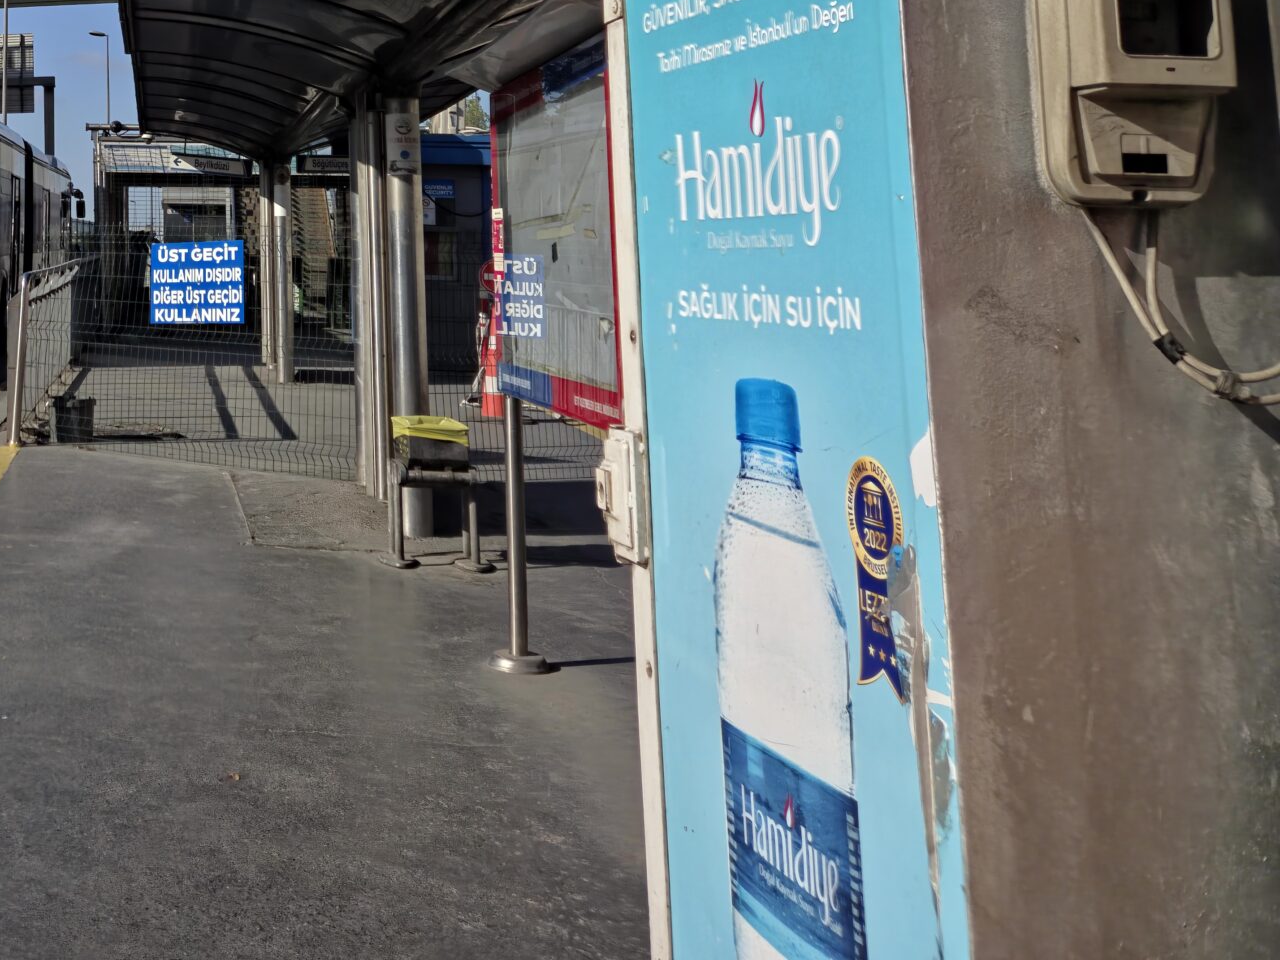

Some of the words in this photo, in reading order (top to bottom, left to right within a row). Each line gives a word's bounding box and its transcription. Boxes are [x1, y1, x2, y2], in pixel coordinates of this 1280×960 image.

[656, 51, 682, 74] Tarihi
[735, 36, 747, 52] ve
[194, 159, 230, 171] Beylikdüzü
[675, 116, 841, 247] Hamidiye
[157, 246, 188, 263] ÜST
[190, 243, 239, 264] GEÇİT
[153, 268, 204, 284] KULLANIM
[205, 268, 241, 285] DIŞIDIR
[153, 288, 184, 305] DİĞER
[185, 287, 206, 304] ÜST
[207, 285, 242, 306] GEÇİDİ
[154, 308, 240, 322] KULLANINIZ
[678, 283, 739, 321] SAĞLIK
[742, 285, 780, 328] İÇİN
[786, 296, 812, 328] SU
[815, 286, 862, 335] İÇİN
[847, 461, 868, 531] INTERNATIONAL
[869, 461, 888, 482] TASTE
[863, 527, 888, 552] 2022
[863, 554, 888, 575] BRUSSEL
[741, 783, 840, 926] Hamidiye
